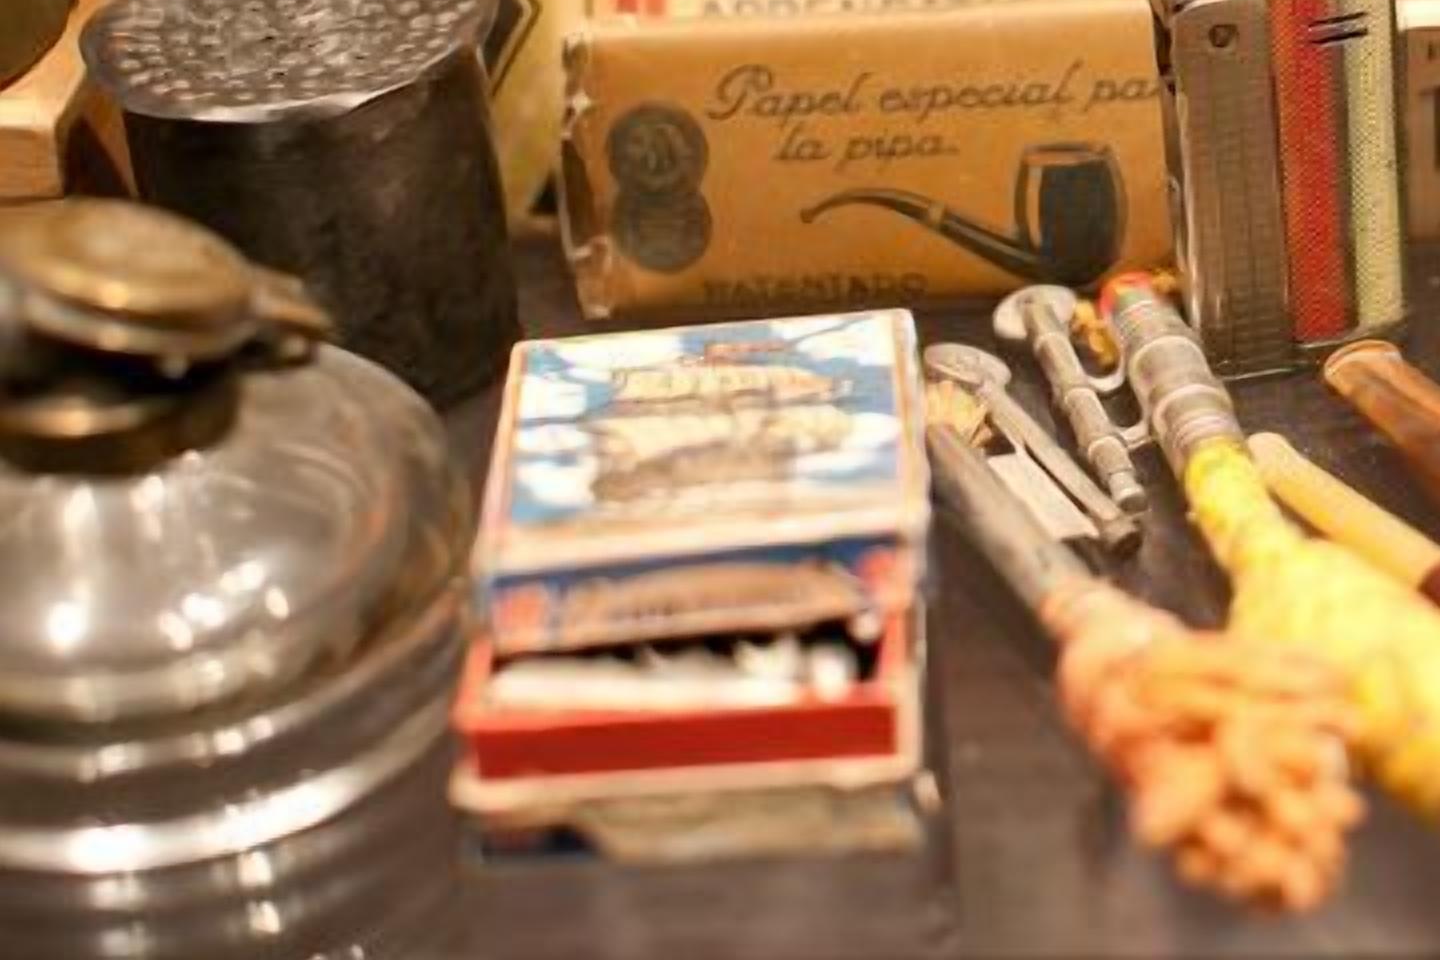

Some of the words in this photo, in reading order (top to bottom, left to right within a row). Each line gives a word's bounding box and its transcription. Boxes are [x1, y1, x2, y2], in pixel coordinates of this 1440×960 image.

[707, 63, 873, 131] Papel
[879, 59, 1084, 124] especial
[1083, 78, 1161, 114] pa
[773, 122, 832, 161] la
